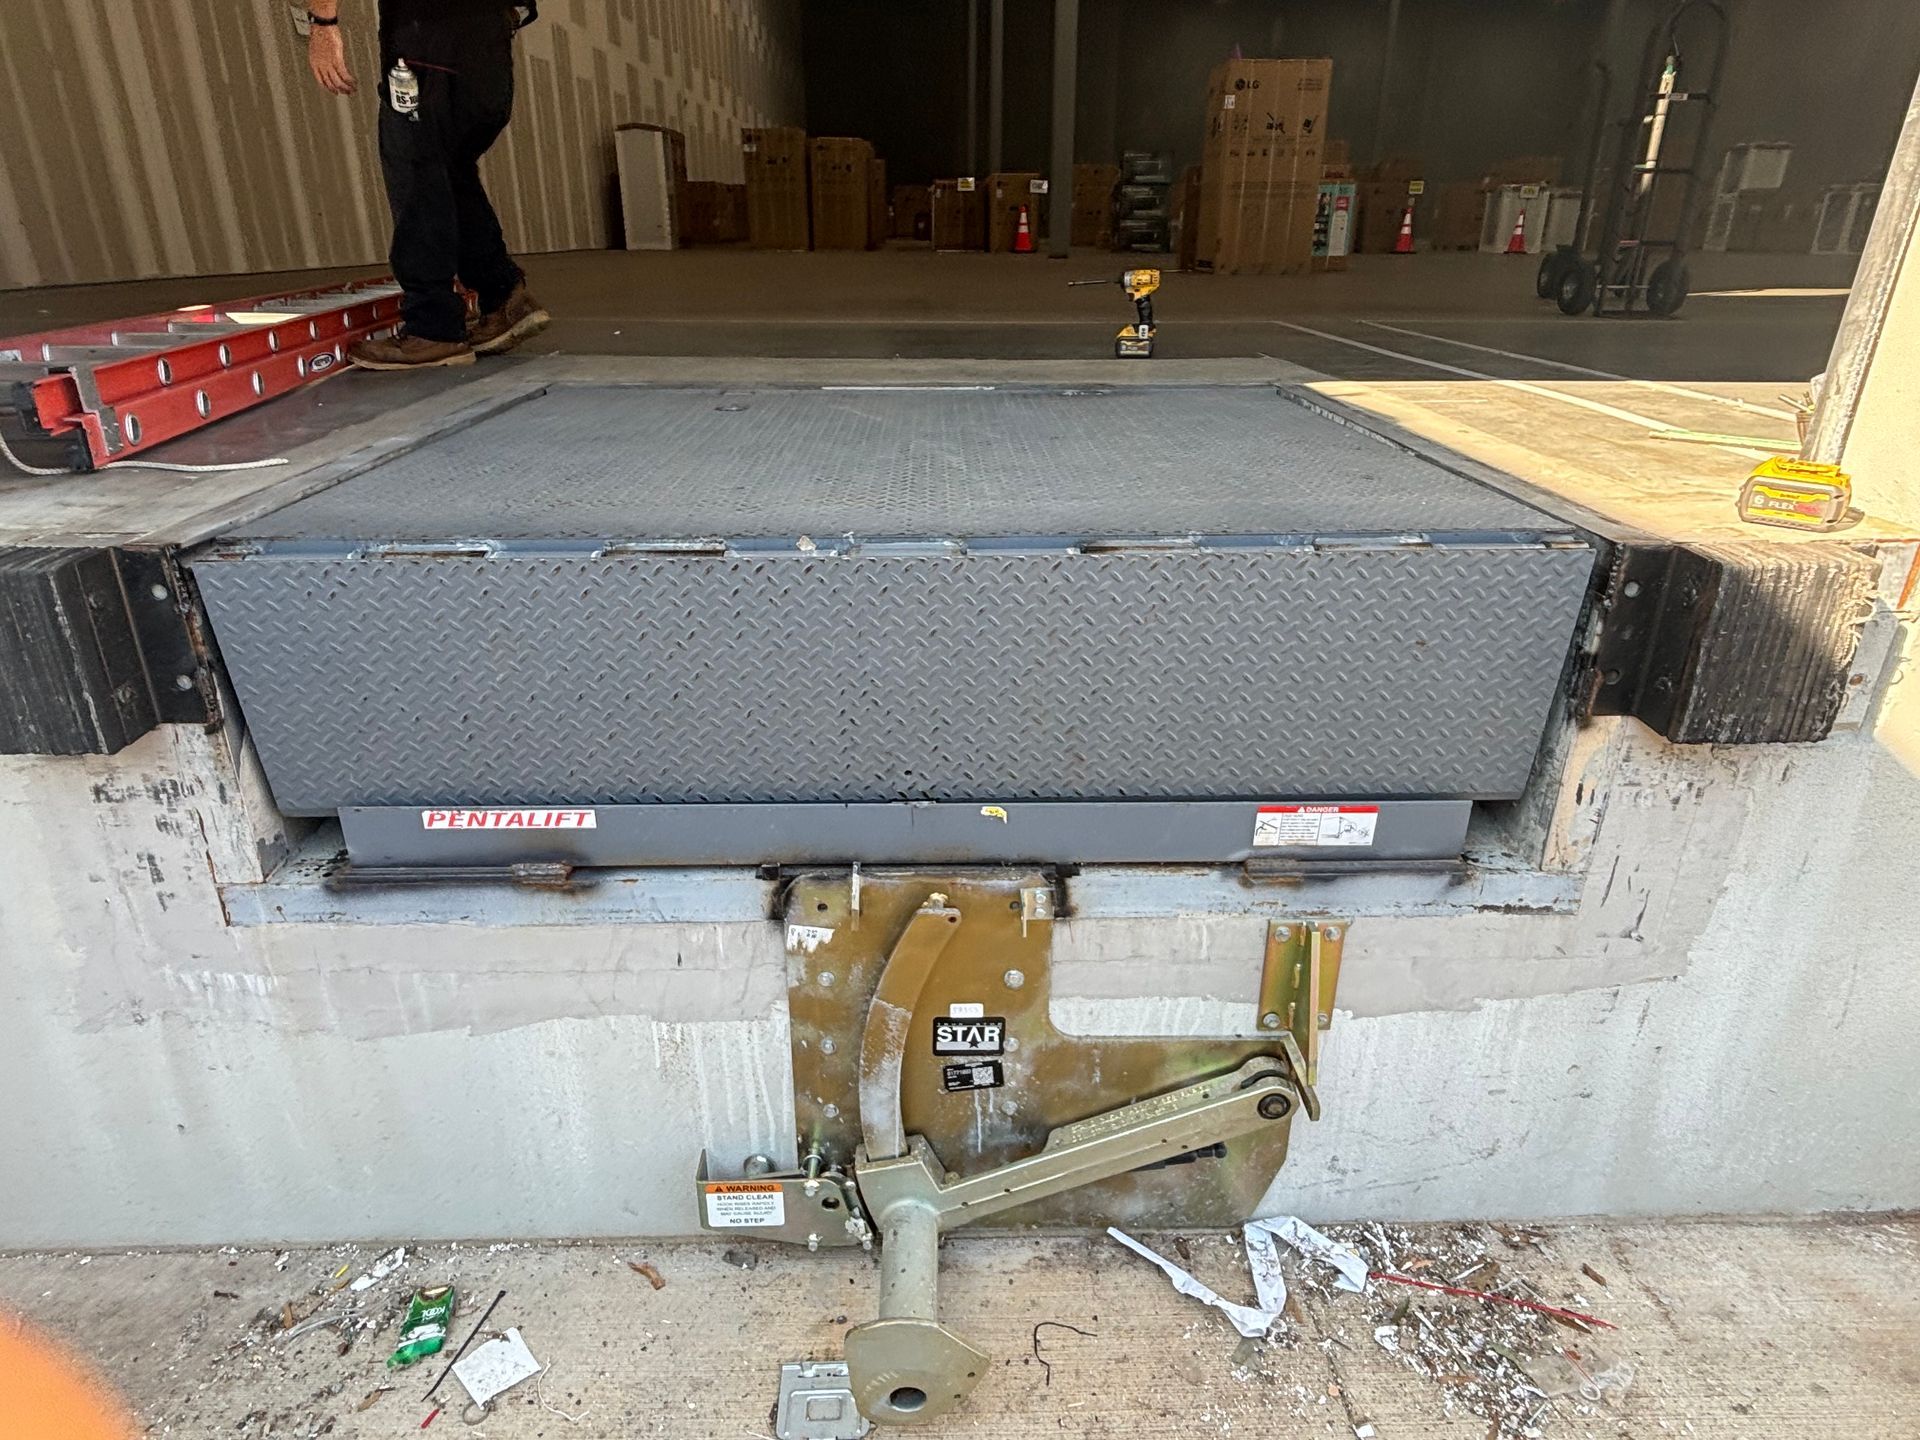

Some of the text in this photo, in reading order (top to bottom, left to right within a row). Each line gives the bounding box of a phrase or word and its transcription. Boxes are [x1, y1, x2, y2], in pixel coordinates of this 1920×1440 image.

[1247, 80, 1260, 89] LG
[1754, 495, 1765, 505] 6
[427, 811, 592, 828] PENTALIFT
[937, 1026, 1001, 1043] STAR
[726, 1184, 775, 1192] WARNING
